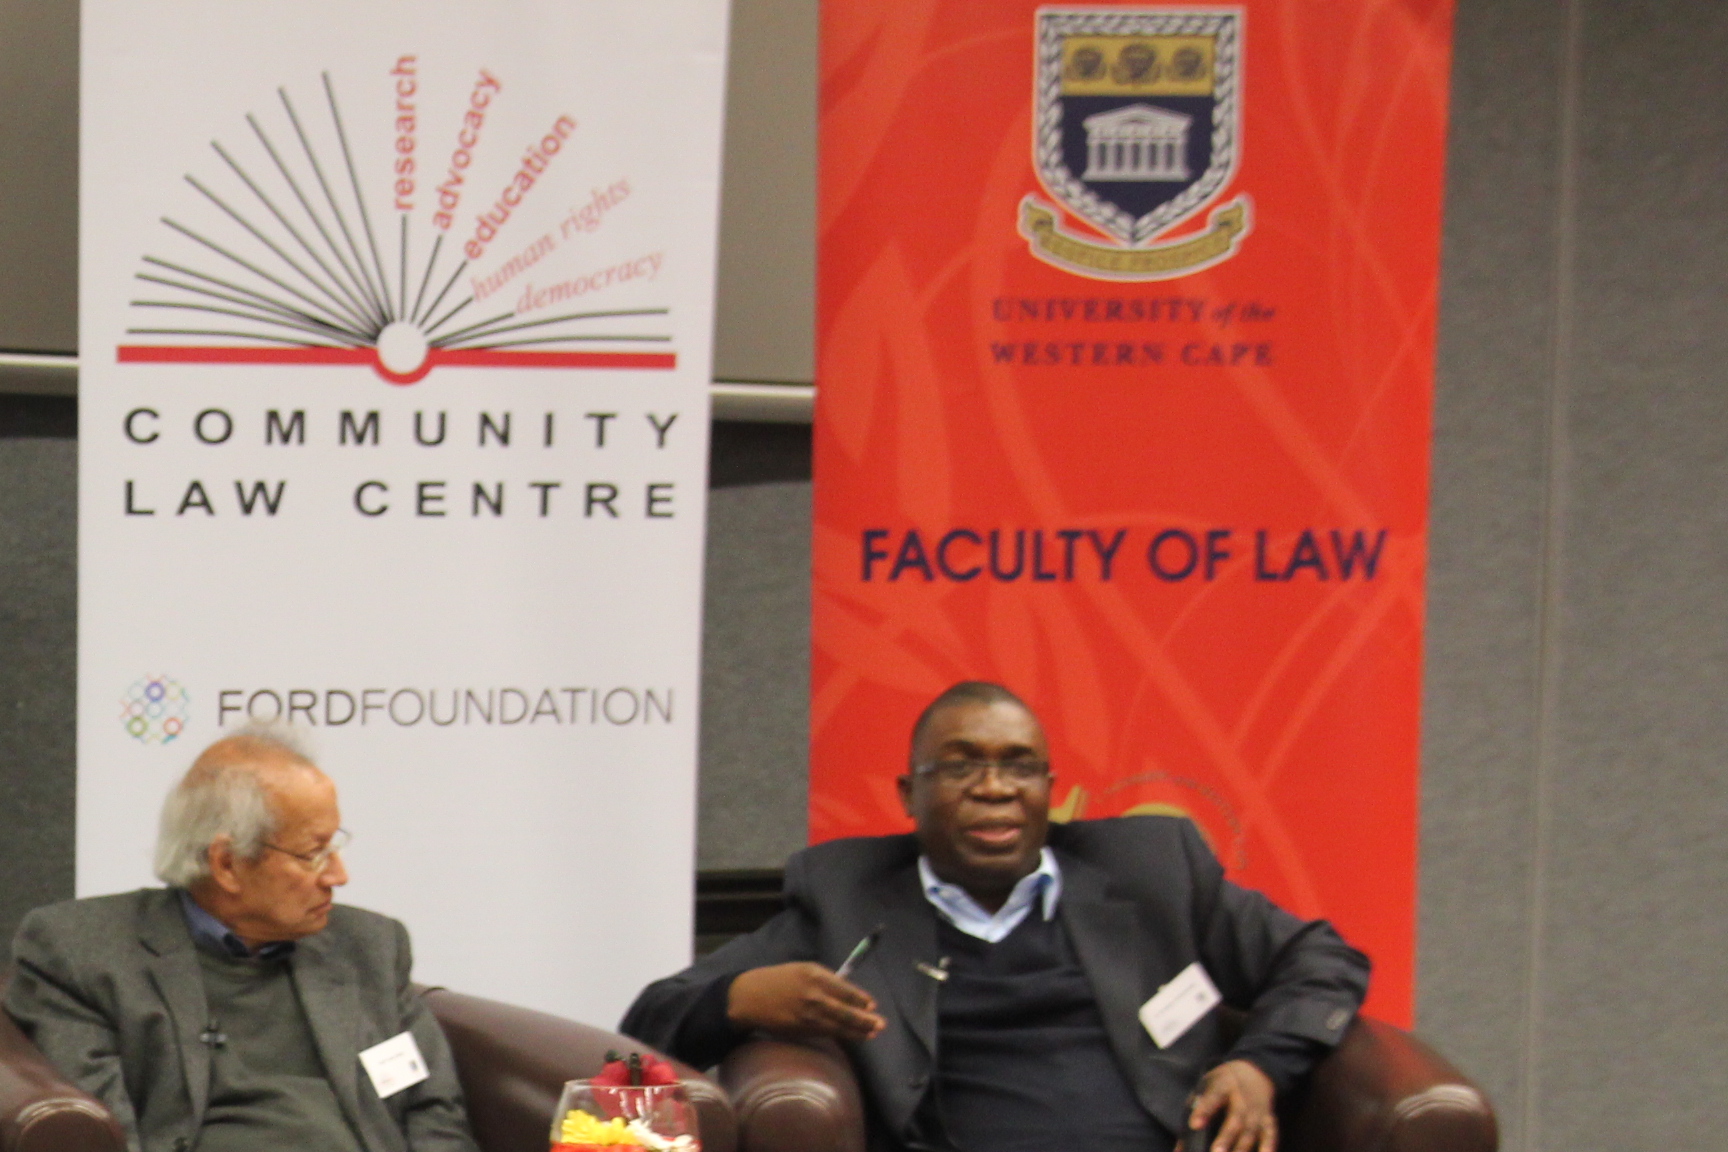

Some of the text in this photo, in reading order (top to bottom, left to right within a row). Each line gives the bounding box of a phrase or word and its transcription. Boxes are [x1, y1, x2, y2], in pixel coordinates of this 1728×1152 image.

[390, 54, 418, 211] research
[431, 67, 502, 231] advocacy
[463, 114, 578, 260] education
[471, 178, 632, 302] human rights
[515, 251, 664, 314] democracy
[991, 296, 1207, 323] UNIVERSITY
[990, 341, 1275, 367] WESTERN CAPE
[122, 406, 679, 449] COMMUNITY
[123, 478, 675, 519] LAW CENTRE
[860, 527, 1389, 584] FACULTY OF LAW
